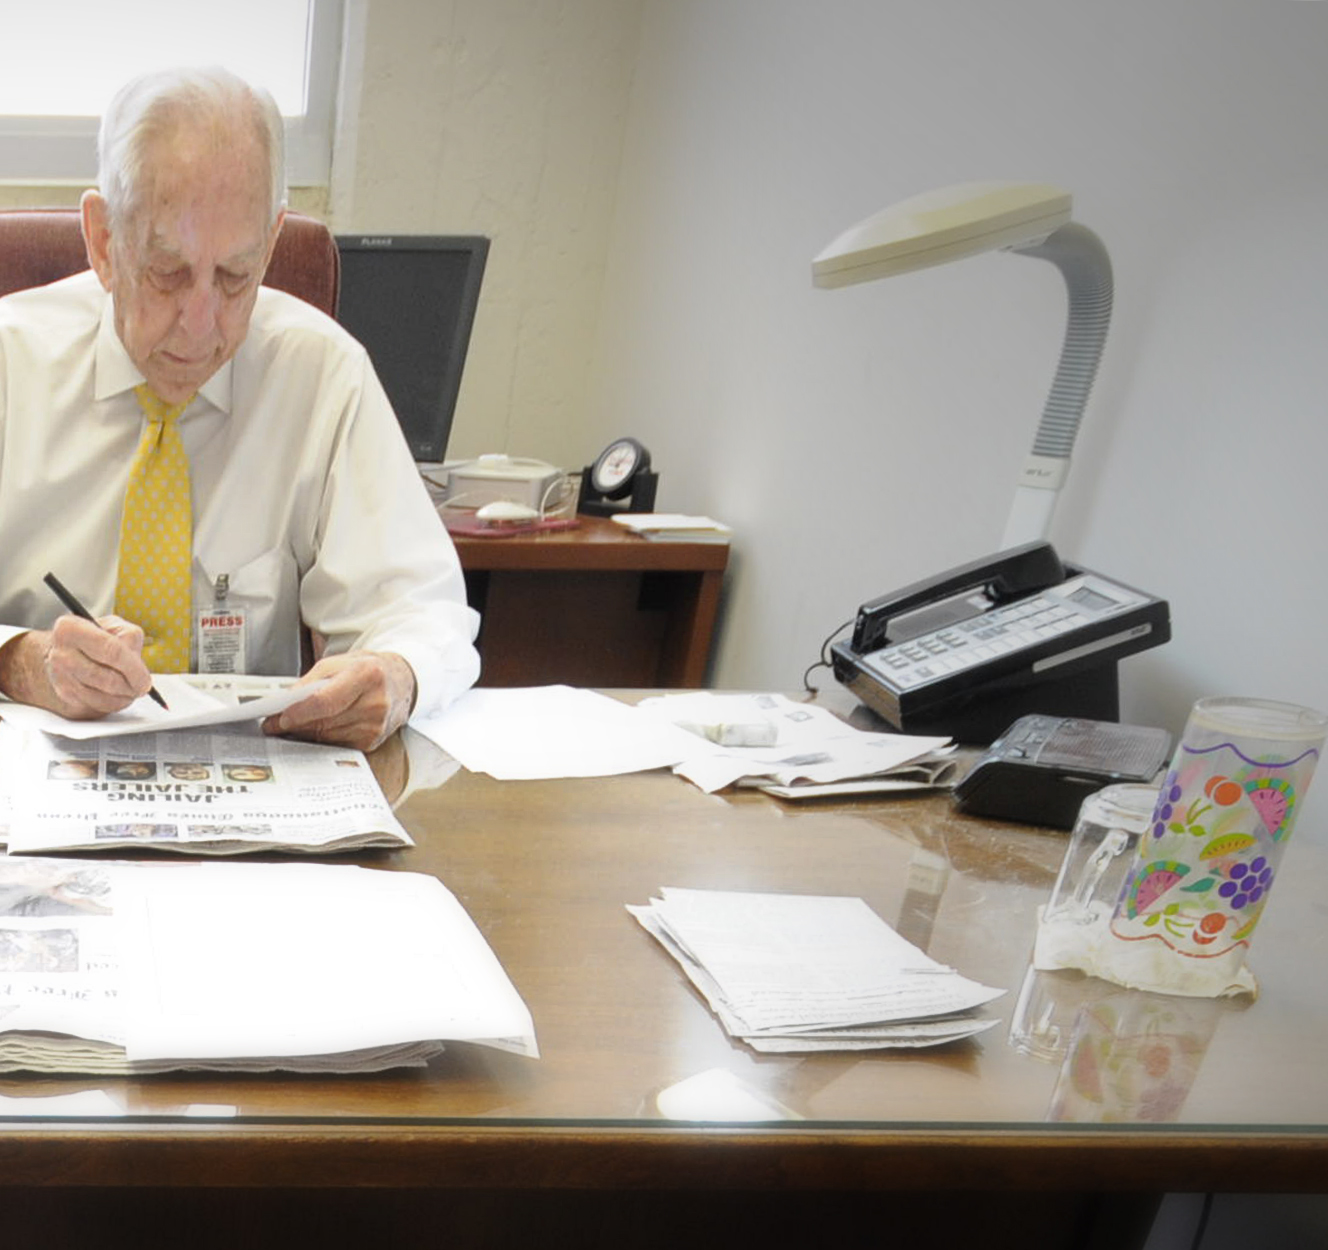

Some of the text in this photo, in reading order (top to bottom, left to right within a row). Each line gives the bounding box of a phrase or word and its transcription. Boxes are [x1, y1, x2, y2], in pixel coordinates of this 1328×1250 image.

[201, 616, 243, 628] PRESS
[73, 781, 253, 794] THE JAILERS
[107, 792, 220, 803] JAILING
